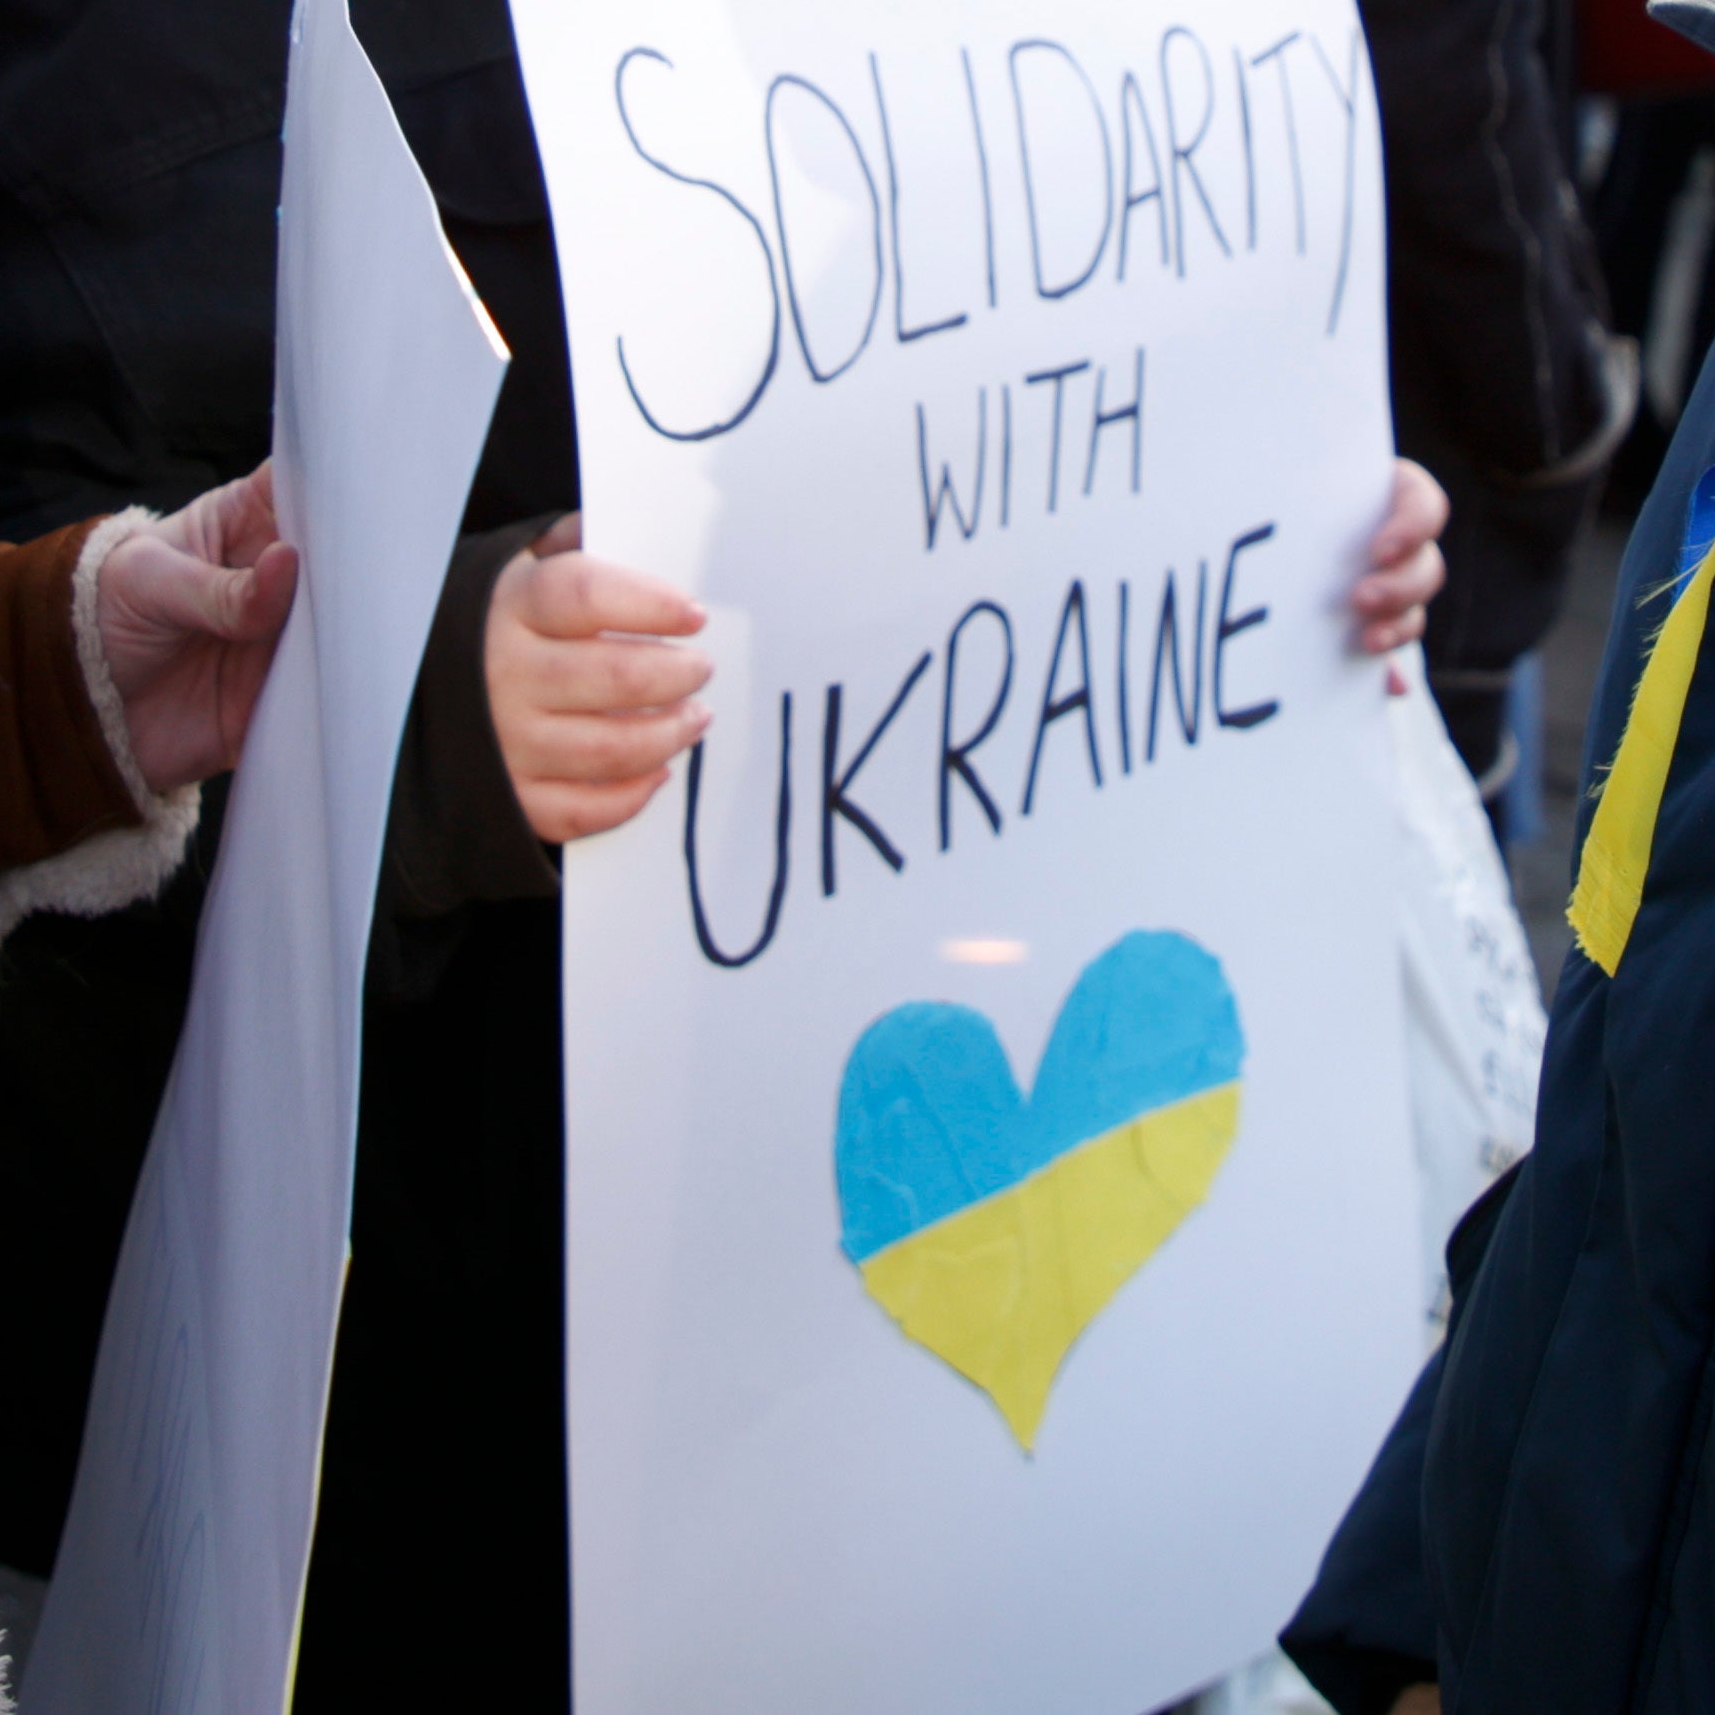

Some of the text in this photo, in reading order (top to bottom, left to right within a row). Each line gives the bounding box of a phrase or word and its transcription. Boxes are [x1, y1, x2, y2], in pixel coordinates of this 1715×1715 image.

[615, 26, 1364, 441] SOLIDARITY
[914, 346, 1148, 551] WITH
[685, 521, 1280, 968] UKRAINE
